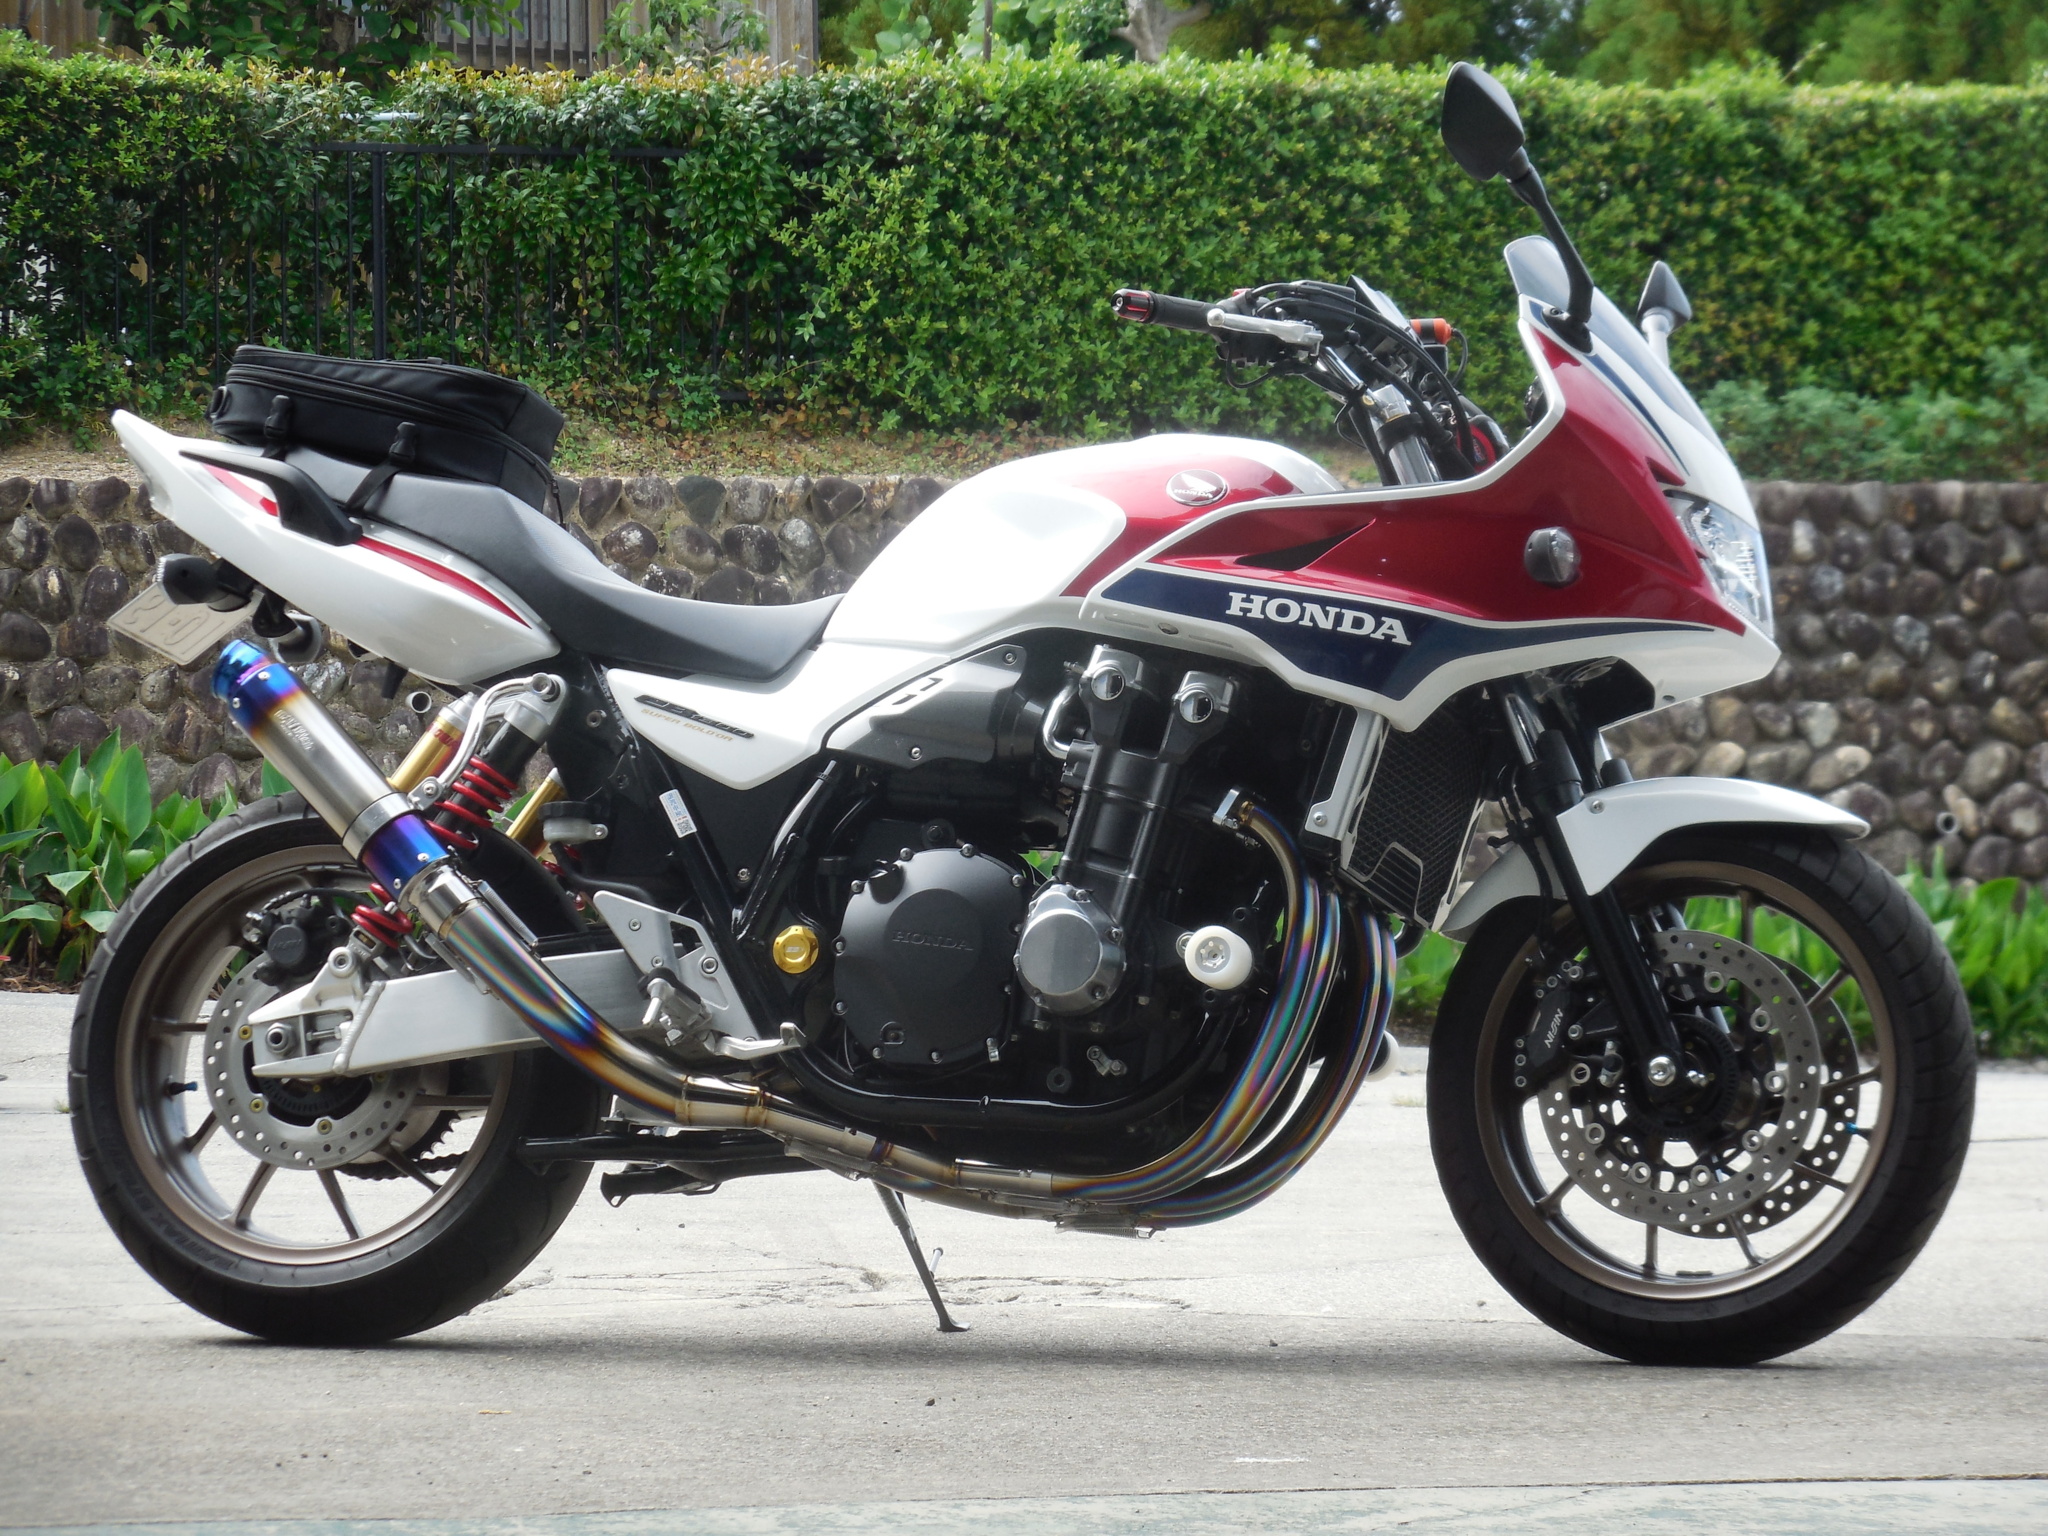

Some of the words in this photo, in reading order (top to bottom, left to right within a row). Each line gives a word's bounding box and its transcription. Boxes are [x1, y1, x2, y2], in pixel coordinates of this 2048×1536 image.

[1173, 488, 1214, 499] HONDA
[1225, 591, 1412, 646] HONDA
[641, 708, 681, 724] SUPER
[892, 930, 974, 951] HONDA
